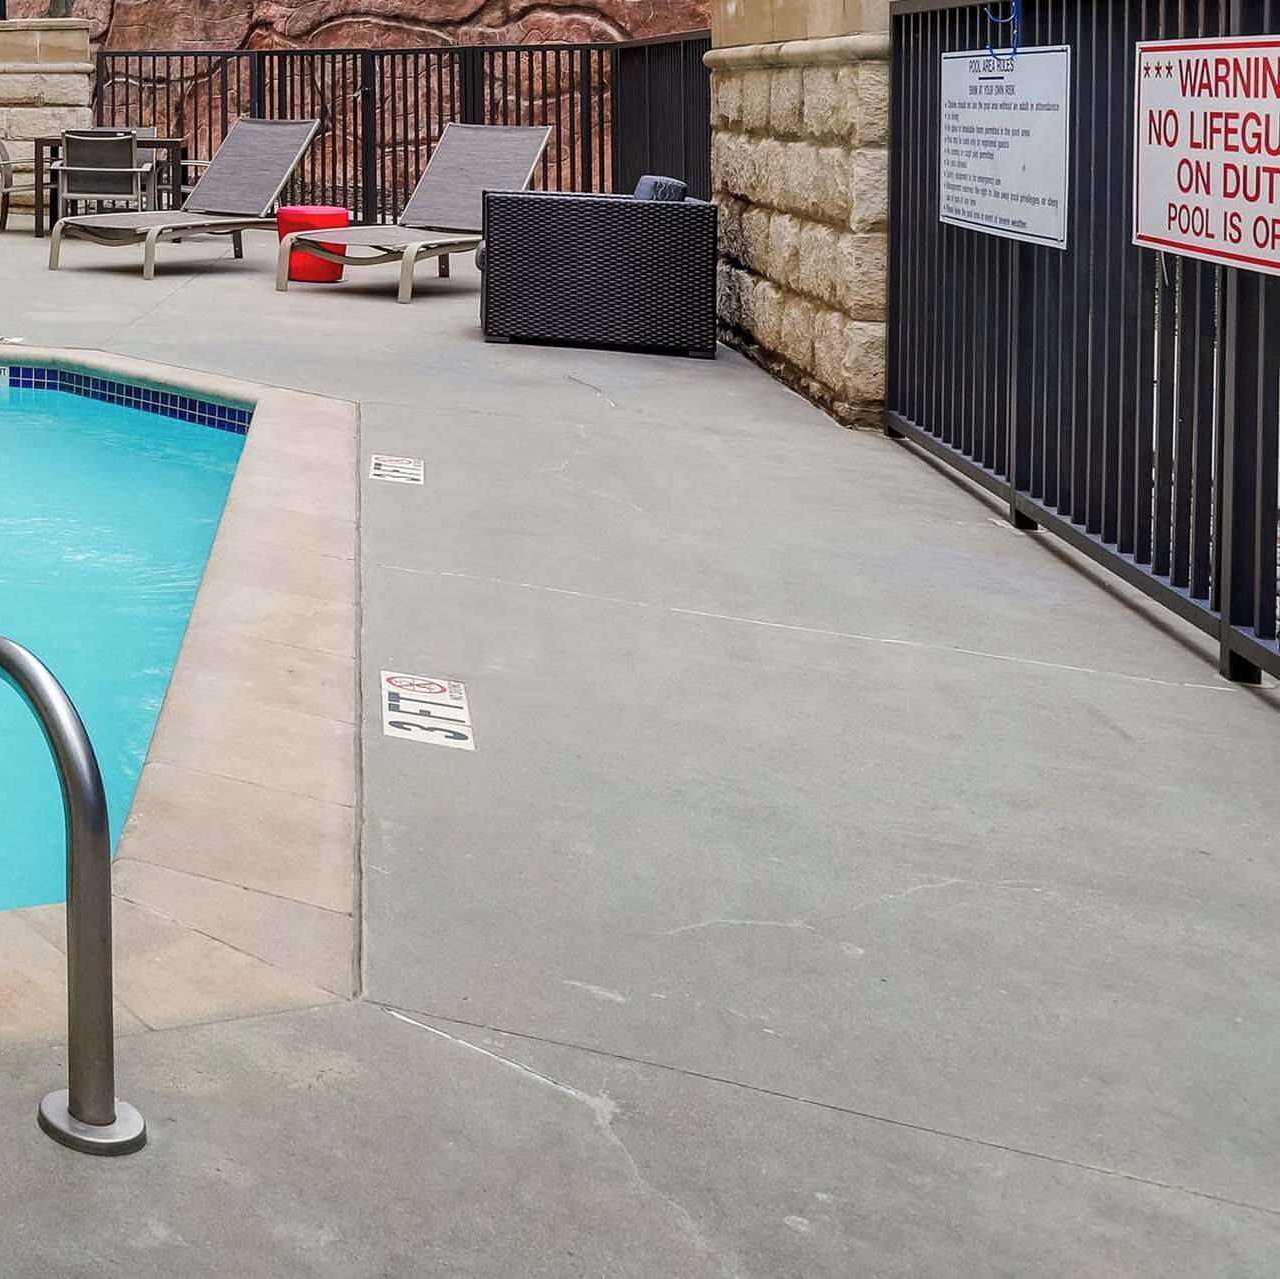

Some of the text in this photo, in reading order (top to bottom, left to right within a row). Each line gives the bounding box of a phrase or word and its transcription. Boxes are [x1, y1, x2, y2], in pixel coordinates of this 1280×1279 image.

[969, 58, 1014, 73] POOL AREA RULES
[1148, 108, 1179, 148] NO
[1177, 158, 1280, 204] ON DUT
[1168, 203, 1215, 240] POOL
[1223, 211, 1242, 245] IS
[388, 691, 469, 741] 3 FT
